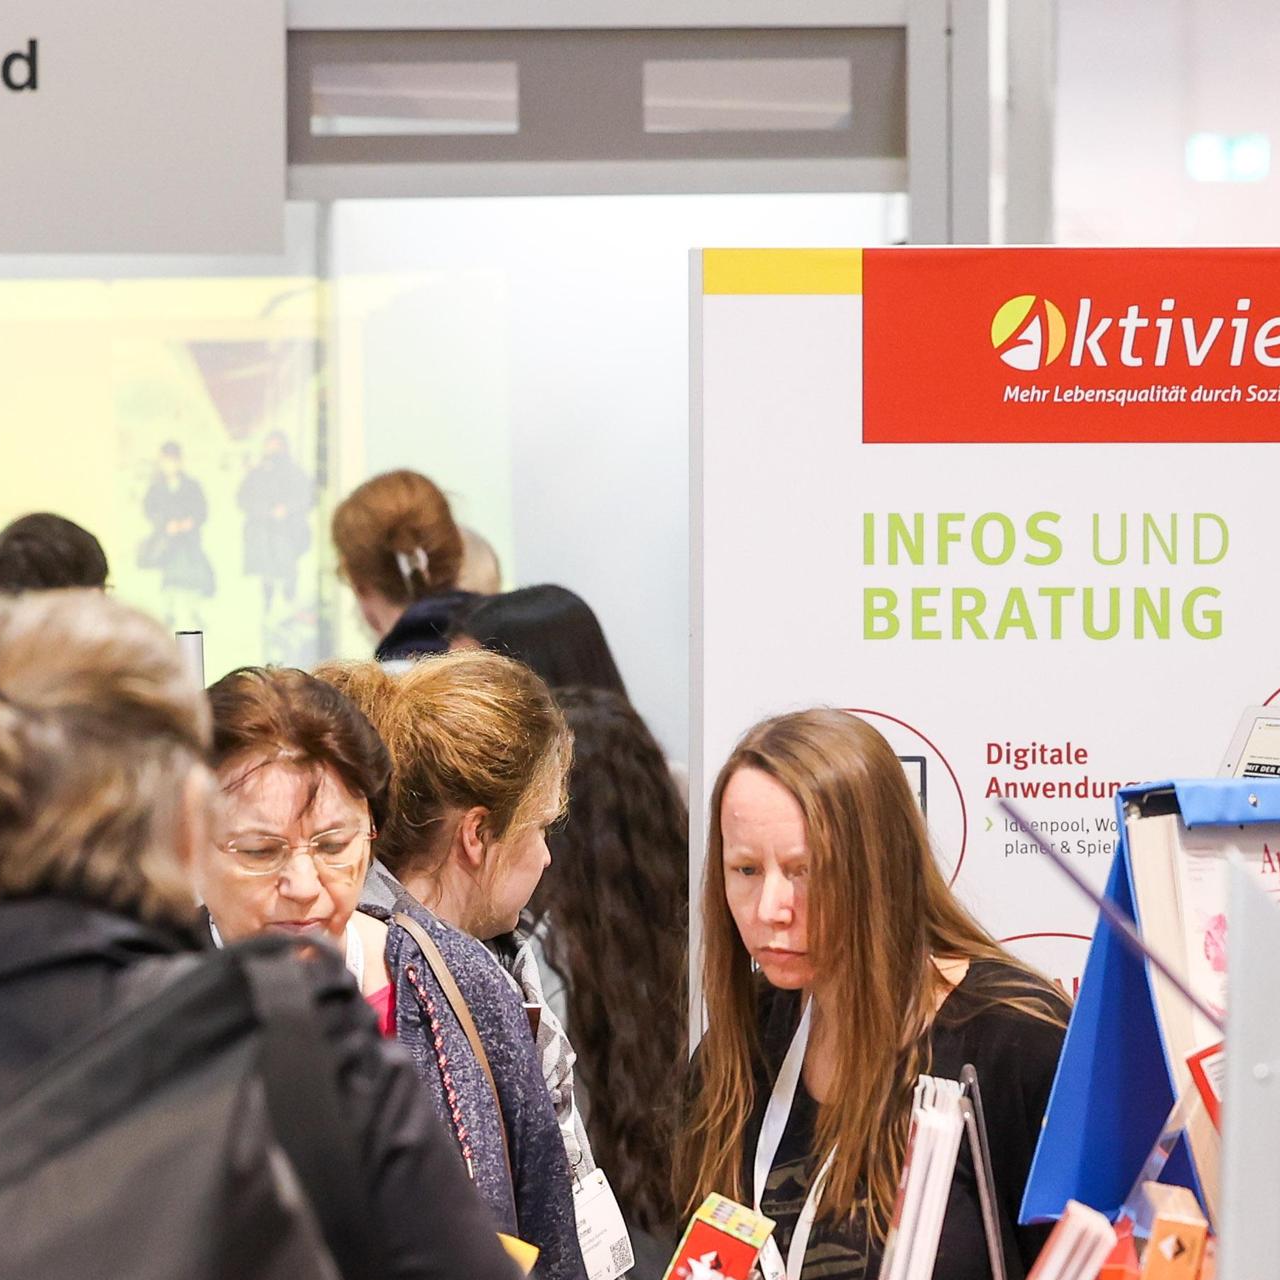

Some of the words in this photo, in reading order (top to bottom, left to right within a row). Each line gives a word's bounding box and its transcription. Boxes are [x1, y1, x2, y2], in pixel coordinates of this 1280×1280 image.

[1003, 385, 1049, 402] Mehr
[1053, 385, 1186, 406] Lebensqualität
[1190, 385, 1242, 402] durch
[863, 511, 1063, 567] INFOS
[1092, 512, 1230, 566] UND
[863, 586, 1224, 641] BERATUNG
[986, 742, 1089, 771] Digitale
[985, 776, 1153, 800] Anwendun
[1060, 840, 1072, 855] &
[1076, 839, 1116, 858] Spiel
